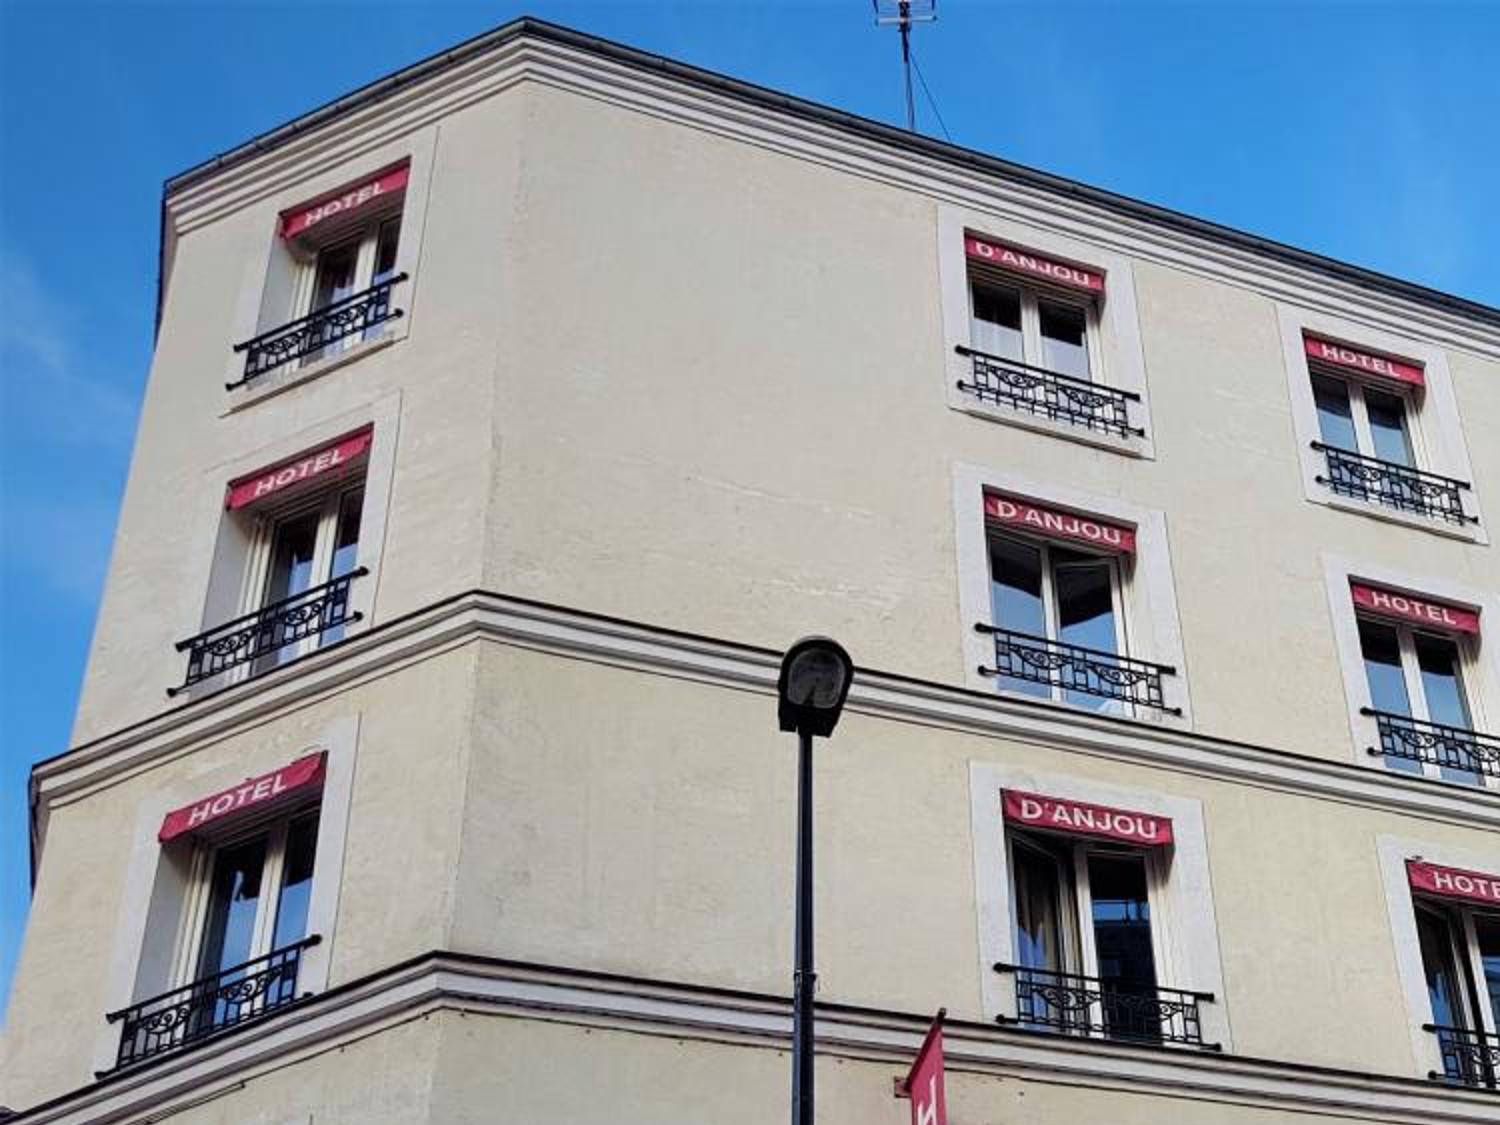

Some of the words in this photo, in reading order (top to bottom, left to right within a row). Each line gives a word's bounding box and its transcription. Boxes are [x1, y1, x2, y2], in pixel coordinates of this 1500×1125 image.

[304, 182, 383, 226] HOTEL
[976, 242, 1089, 287] D'ANJOU
[1321, 344, 1400, 377] HOTEL
[254, 449, 345, 497] HOTEL
[997, 501, 1120, 545] D'ANJOU
[1371, 592, 1456, 624] HOTEL
[188, 774, 287, 826] HOTEL
[1022, 799, 1156, 839] D'ANJOU
